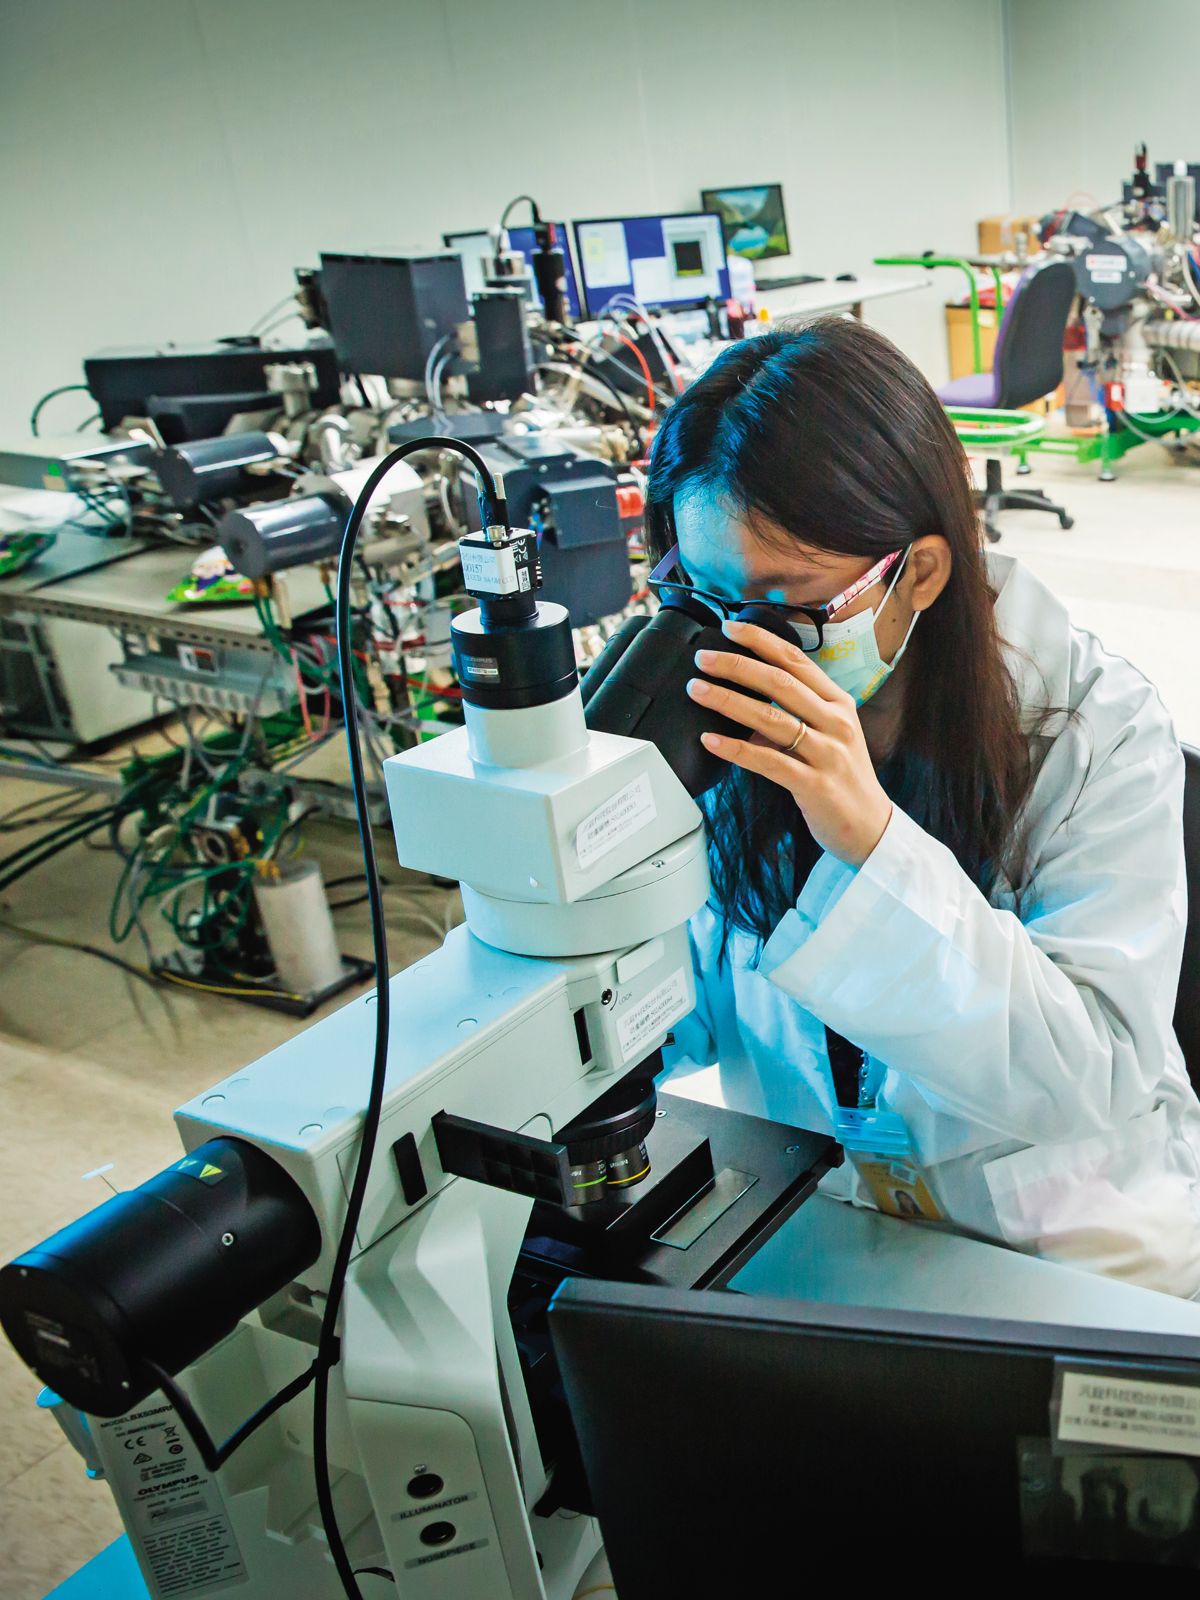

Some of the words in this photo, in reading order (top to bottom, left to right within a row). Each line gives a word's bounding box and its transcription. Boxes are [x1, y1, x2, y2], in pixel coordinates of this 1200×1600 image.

[138, 1474, 199, 1496] OLYMPUS
[400, 1495, 469, 1520] ILLUMINATOR
[418, 1542, 476, 1565] NOSEPIECE
